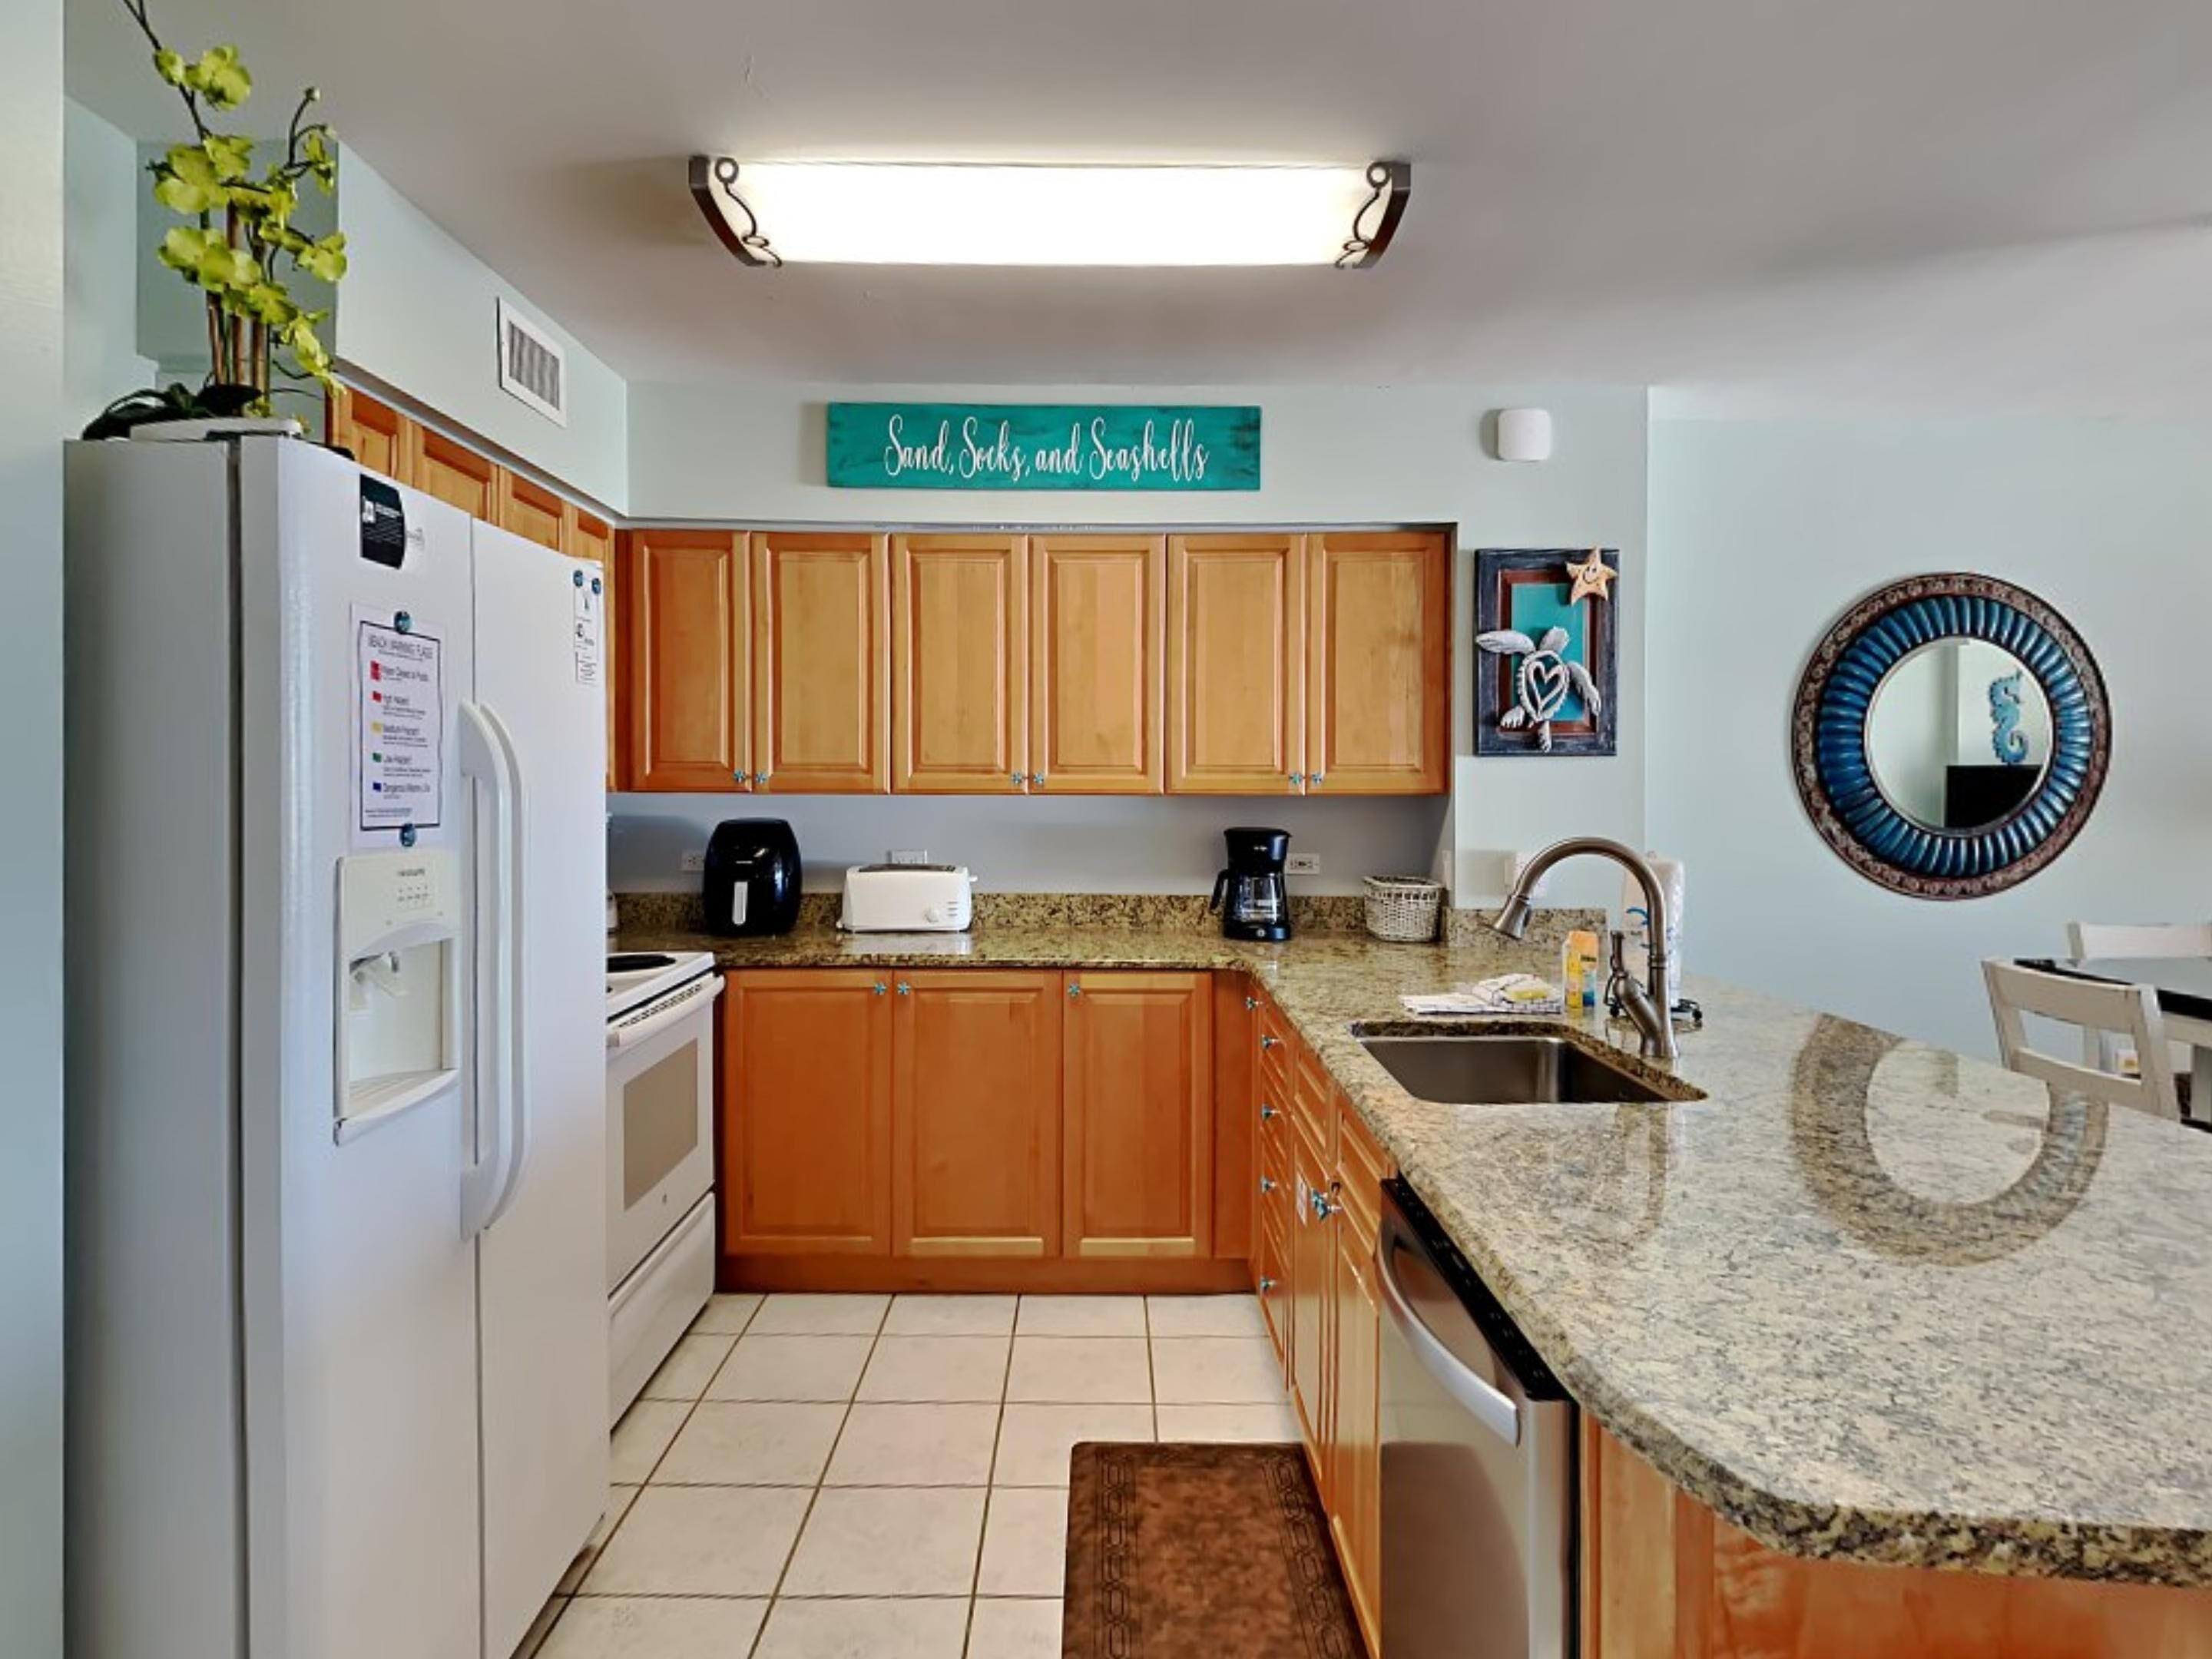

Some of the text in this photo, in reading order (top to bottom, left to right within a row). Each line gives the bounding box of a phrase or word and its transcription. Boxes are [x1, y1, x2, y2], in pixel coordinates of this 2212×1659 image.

[885, 414, 1210, 483] Sand, Socks, and Seashells
